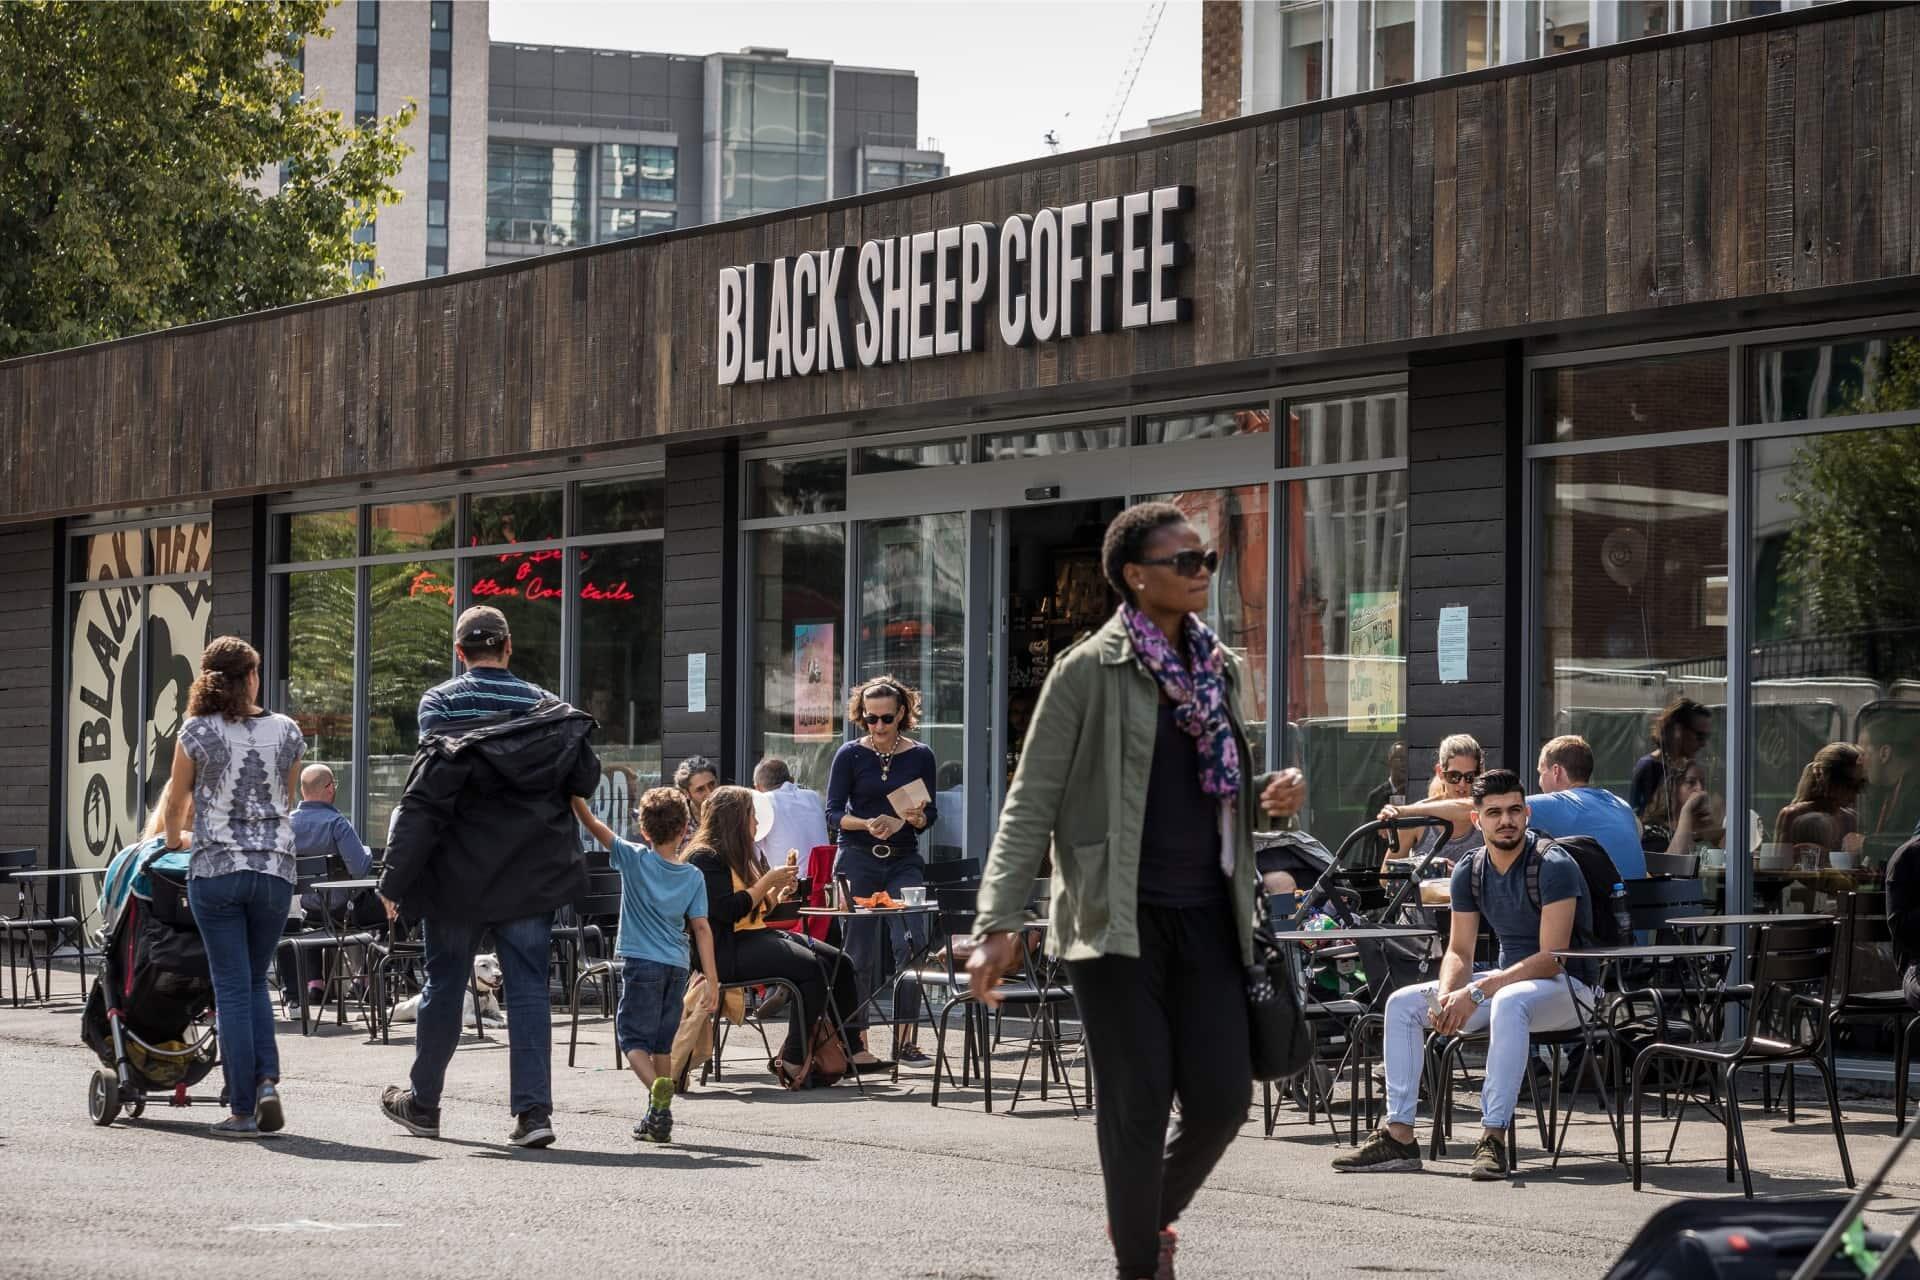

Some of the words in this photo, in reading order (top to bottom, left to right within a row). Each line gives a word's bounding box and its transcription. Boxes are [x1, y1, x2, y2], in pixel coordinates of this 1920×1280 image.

[717, 246, 850, 386] BLACK
[855, 222, 992, 367] SHEEP
[1000, 186, 1185, 348] COFFEE
[409, 570, 519, 605] Forgtten
[524, 576, 636, 601] Coctails
